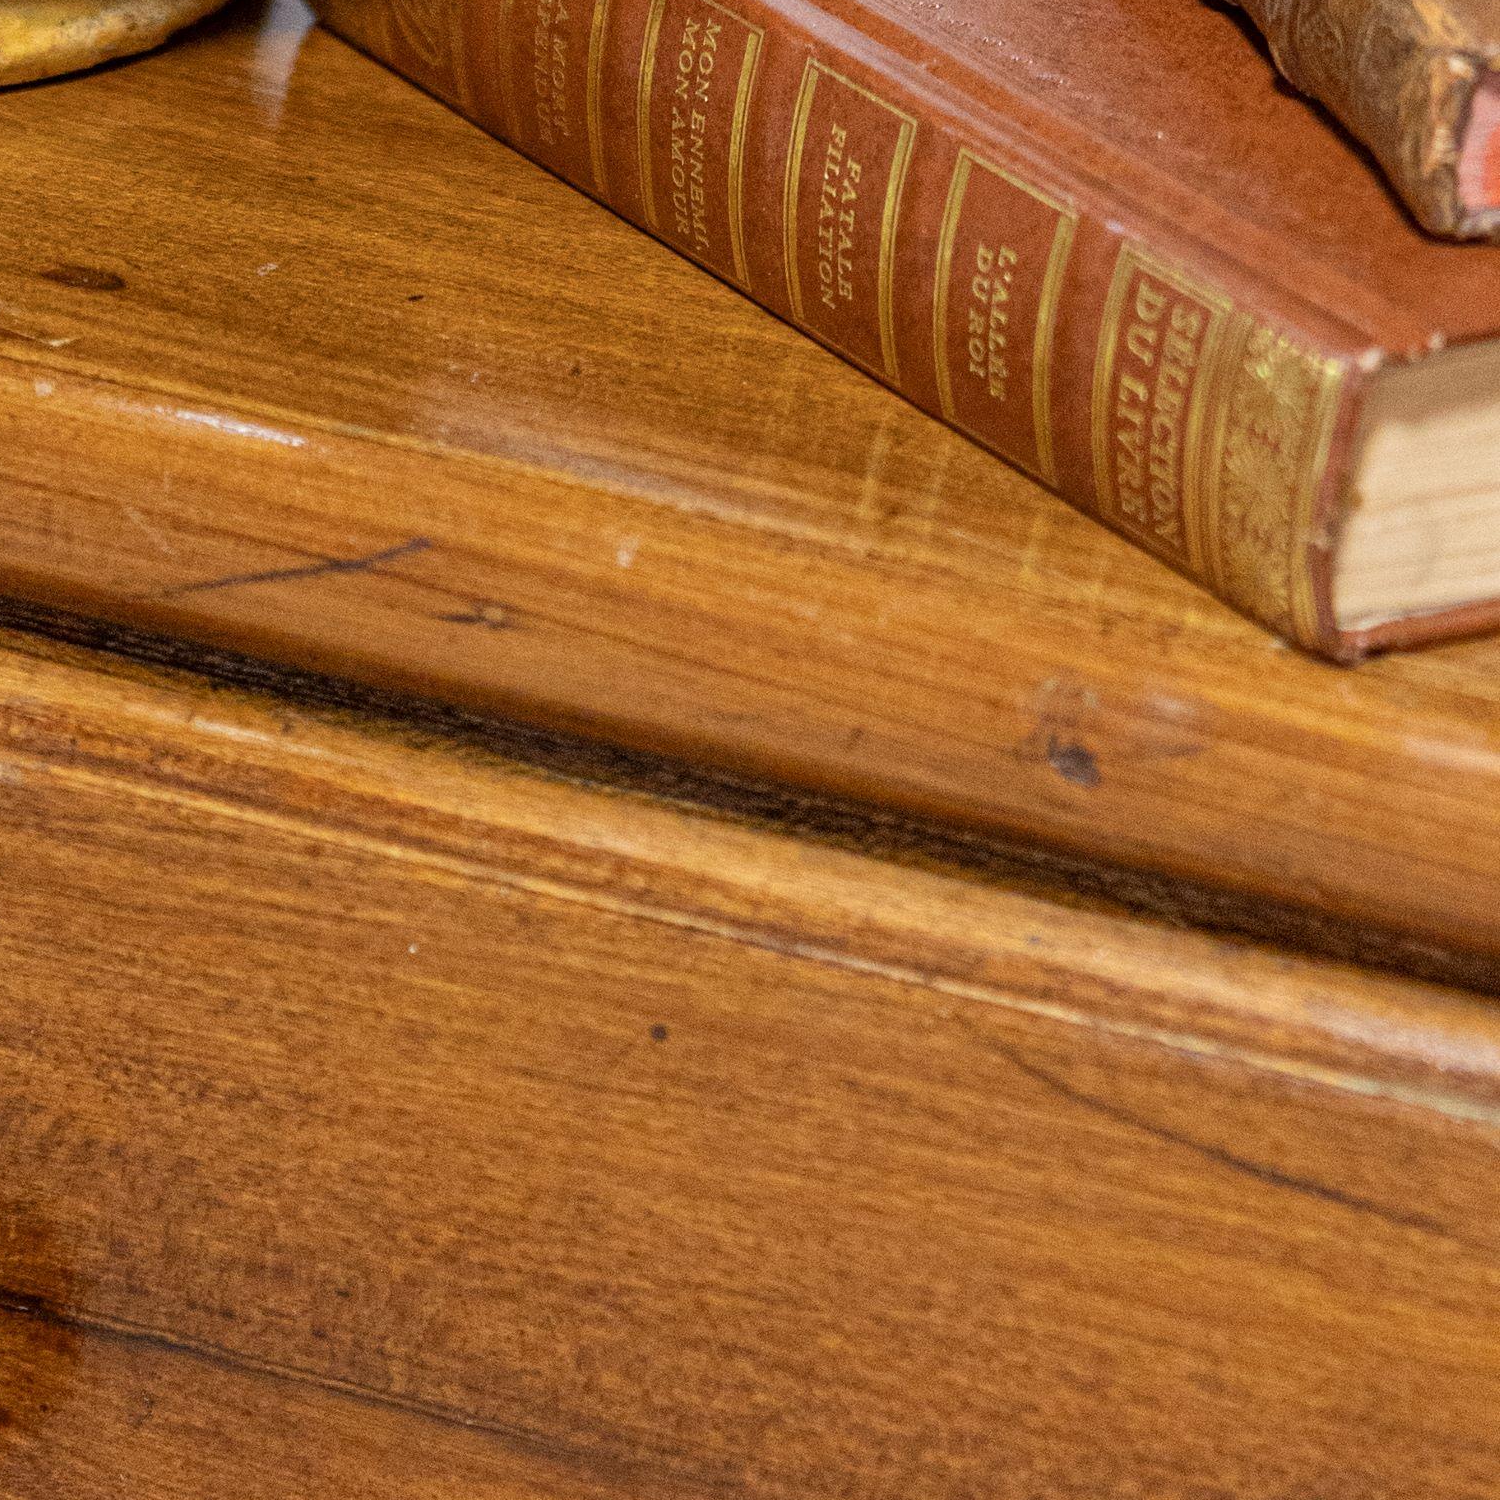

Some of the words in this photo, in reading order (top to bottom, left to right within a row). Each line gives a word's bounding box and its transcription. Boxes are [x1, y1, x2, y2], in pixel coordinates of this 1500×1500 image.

[551, 34, 572, 137] MORT
[675, 16, 700, 100] MON
[699, 17, 722, 102] MON
[671, 106, 690, 235] AMOUR
[818, 123, 847, 309] FILIATION
[837, 157, 861, 301] FATALE
[972, 242, 994, 303] DU
[968, 307, 987, 379] ROI
[1127, 280, 1166, 368] DU
[1116, 372, 1149, 525] LIVRE
